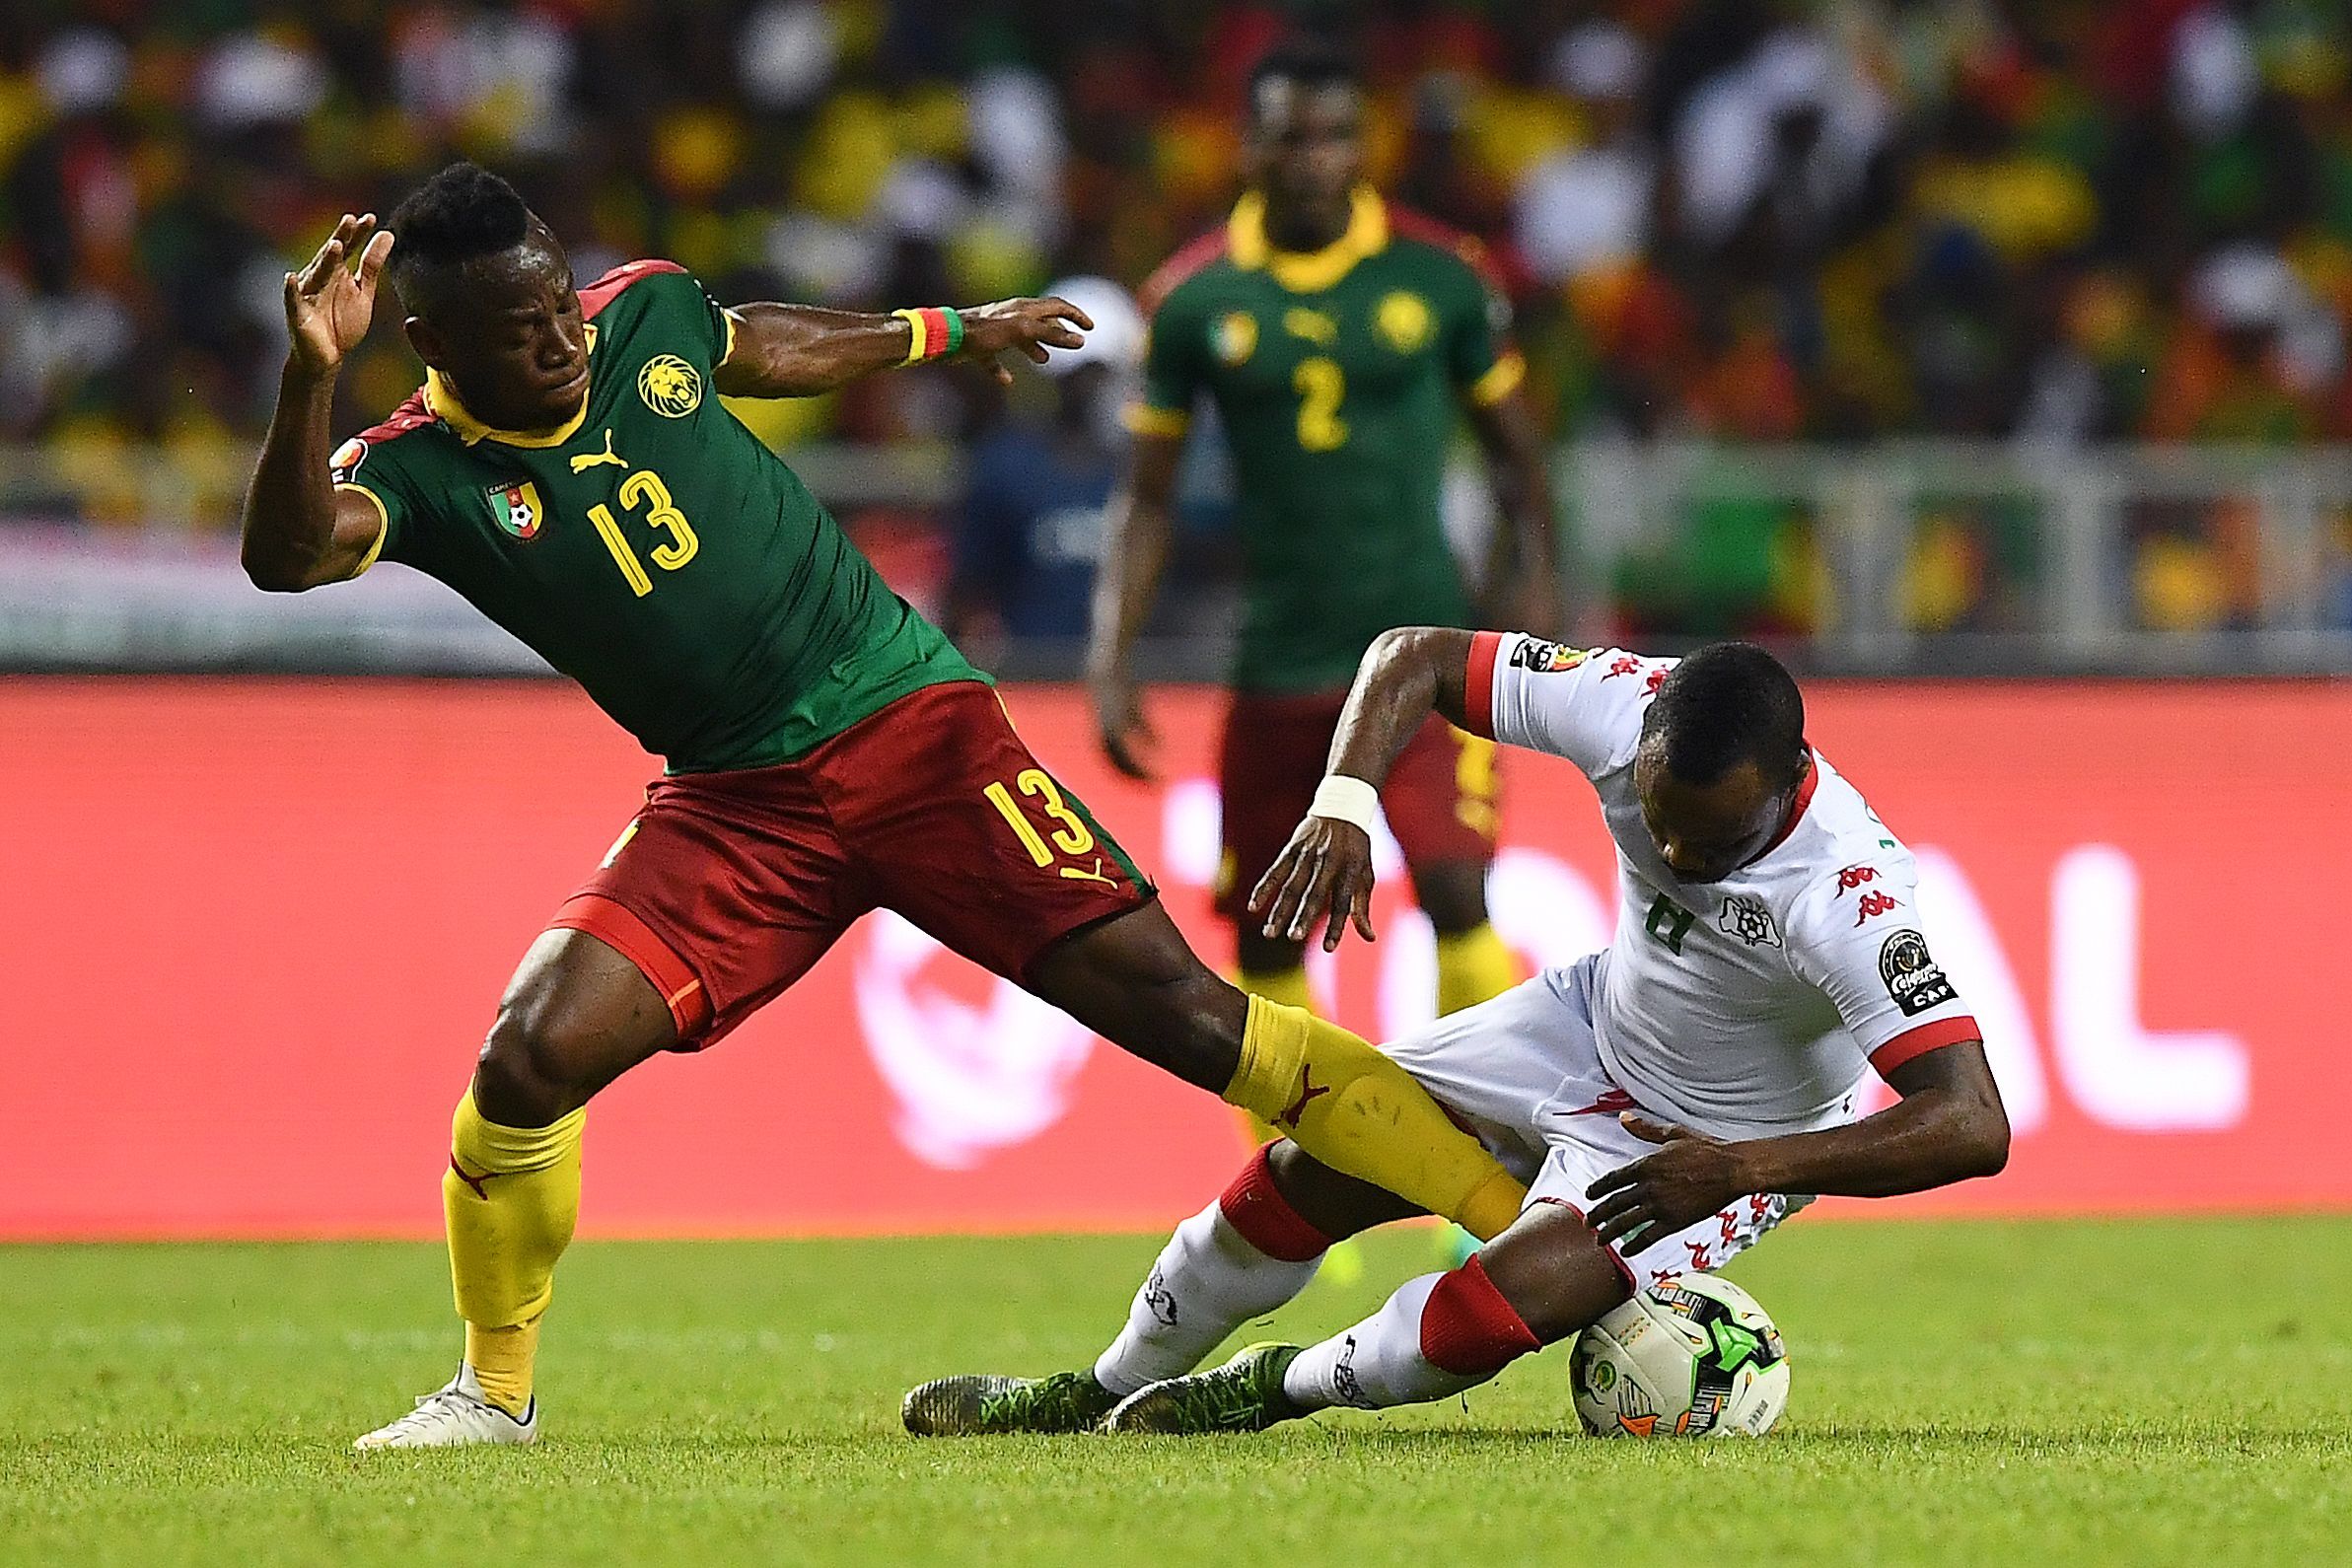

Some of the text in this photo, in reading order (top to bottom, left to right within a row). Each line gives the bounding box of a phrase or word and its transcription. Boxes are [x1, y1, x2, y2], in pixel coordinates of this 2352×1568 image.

[1293, 356, 1348, 454] 2
[587, 470, 699, 598] 13
[983, 768, 1095, 868] 13
